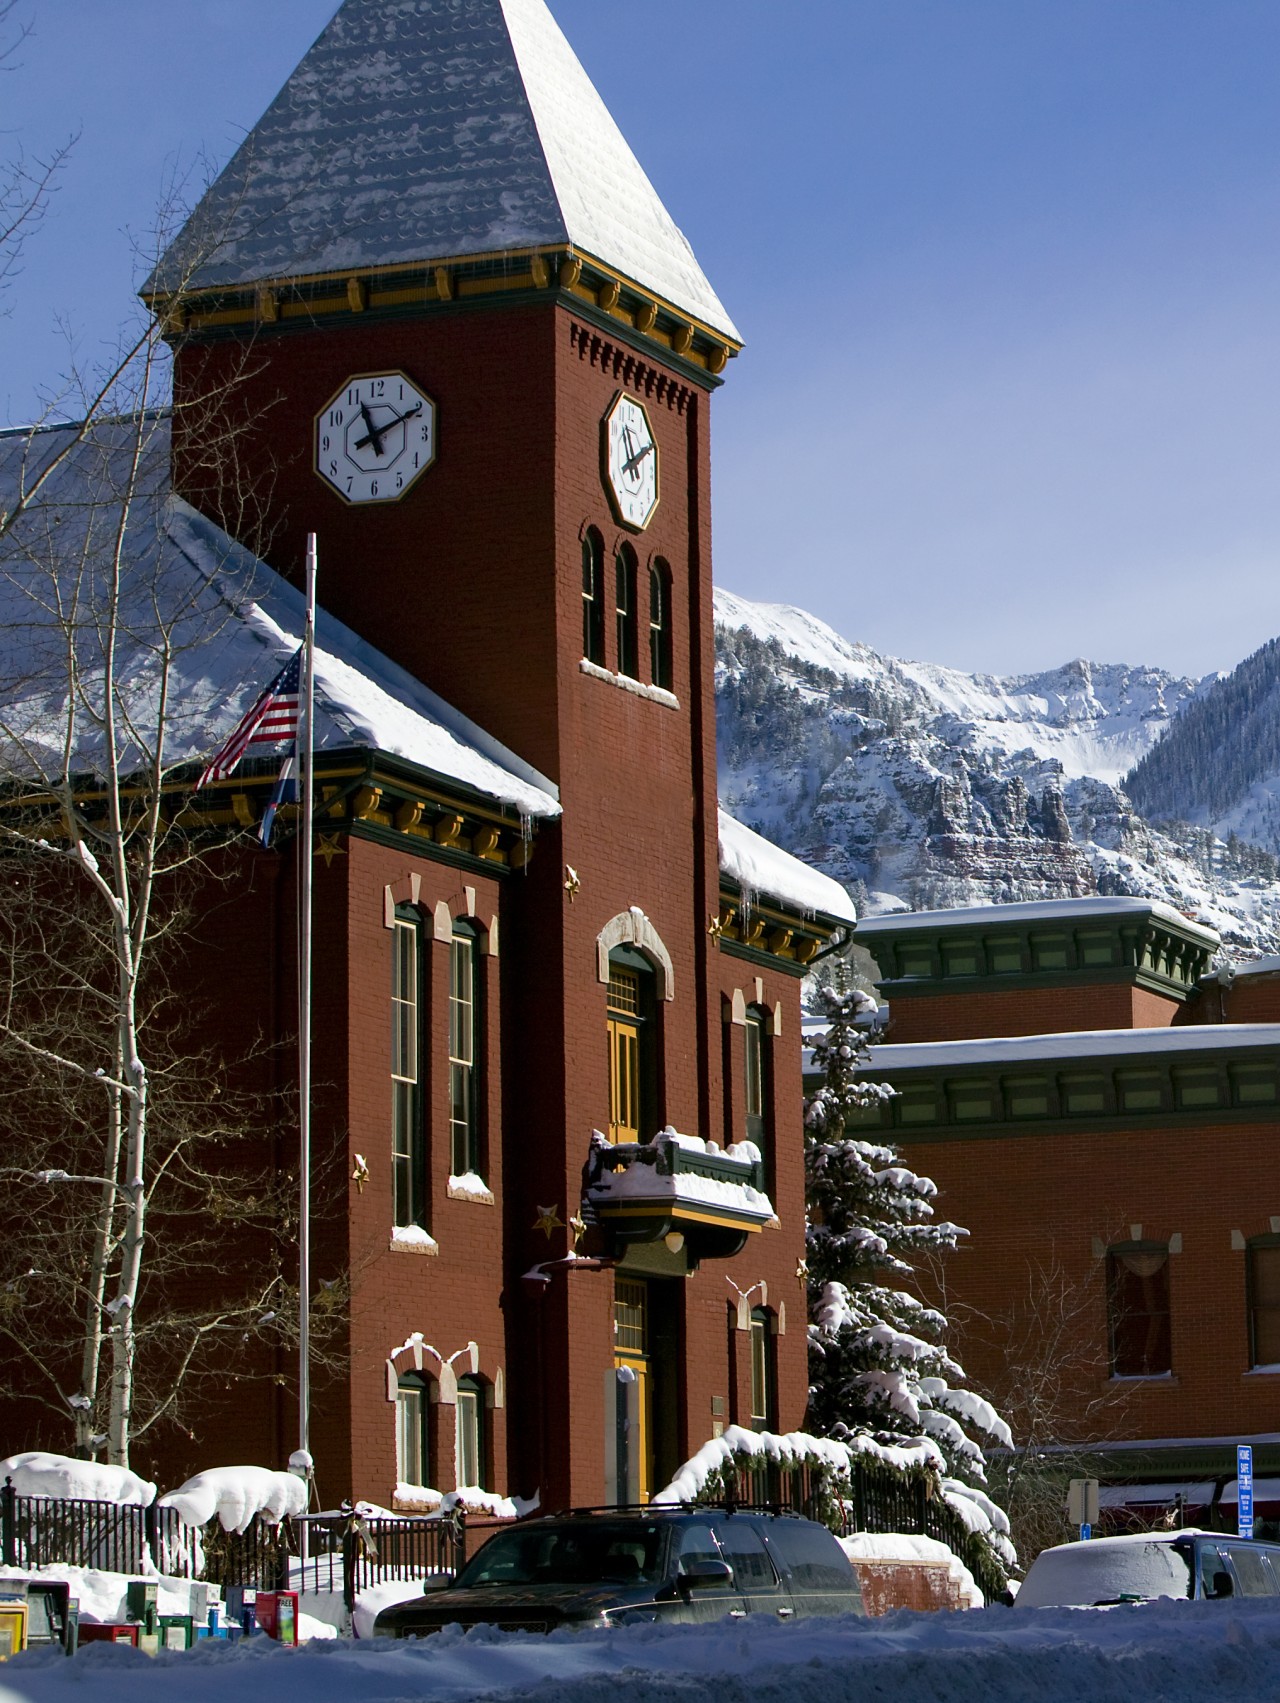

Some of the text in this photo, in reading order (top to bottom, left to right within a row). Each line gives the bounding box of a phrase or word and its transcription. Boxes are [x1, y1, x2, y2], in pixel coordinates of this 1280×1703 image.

[348, 388, 360, 405] 11
[370, 380, 385, 398] 12
[398, 384, 403, 400] 1
[329, 409, 343, 427] 10
[628, 405, 635, 423] 12
[421, 425, 428, 442] 3
[322, 436, 330, 452] 9
[329, 460, 338, 477] 8
[412, 451, 419, 469] 4
[346, 476, 354, 493] 7
[370, 479, 378, 497] 6
[396, 471, 403, 489] 5
